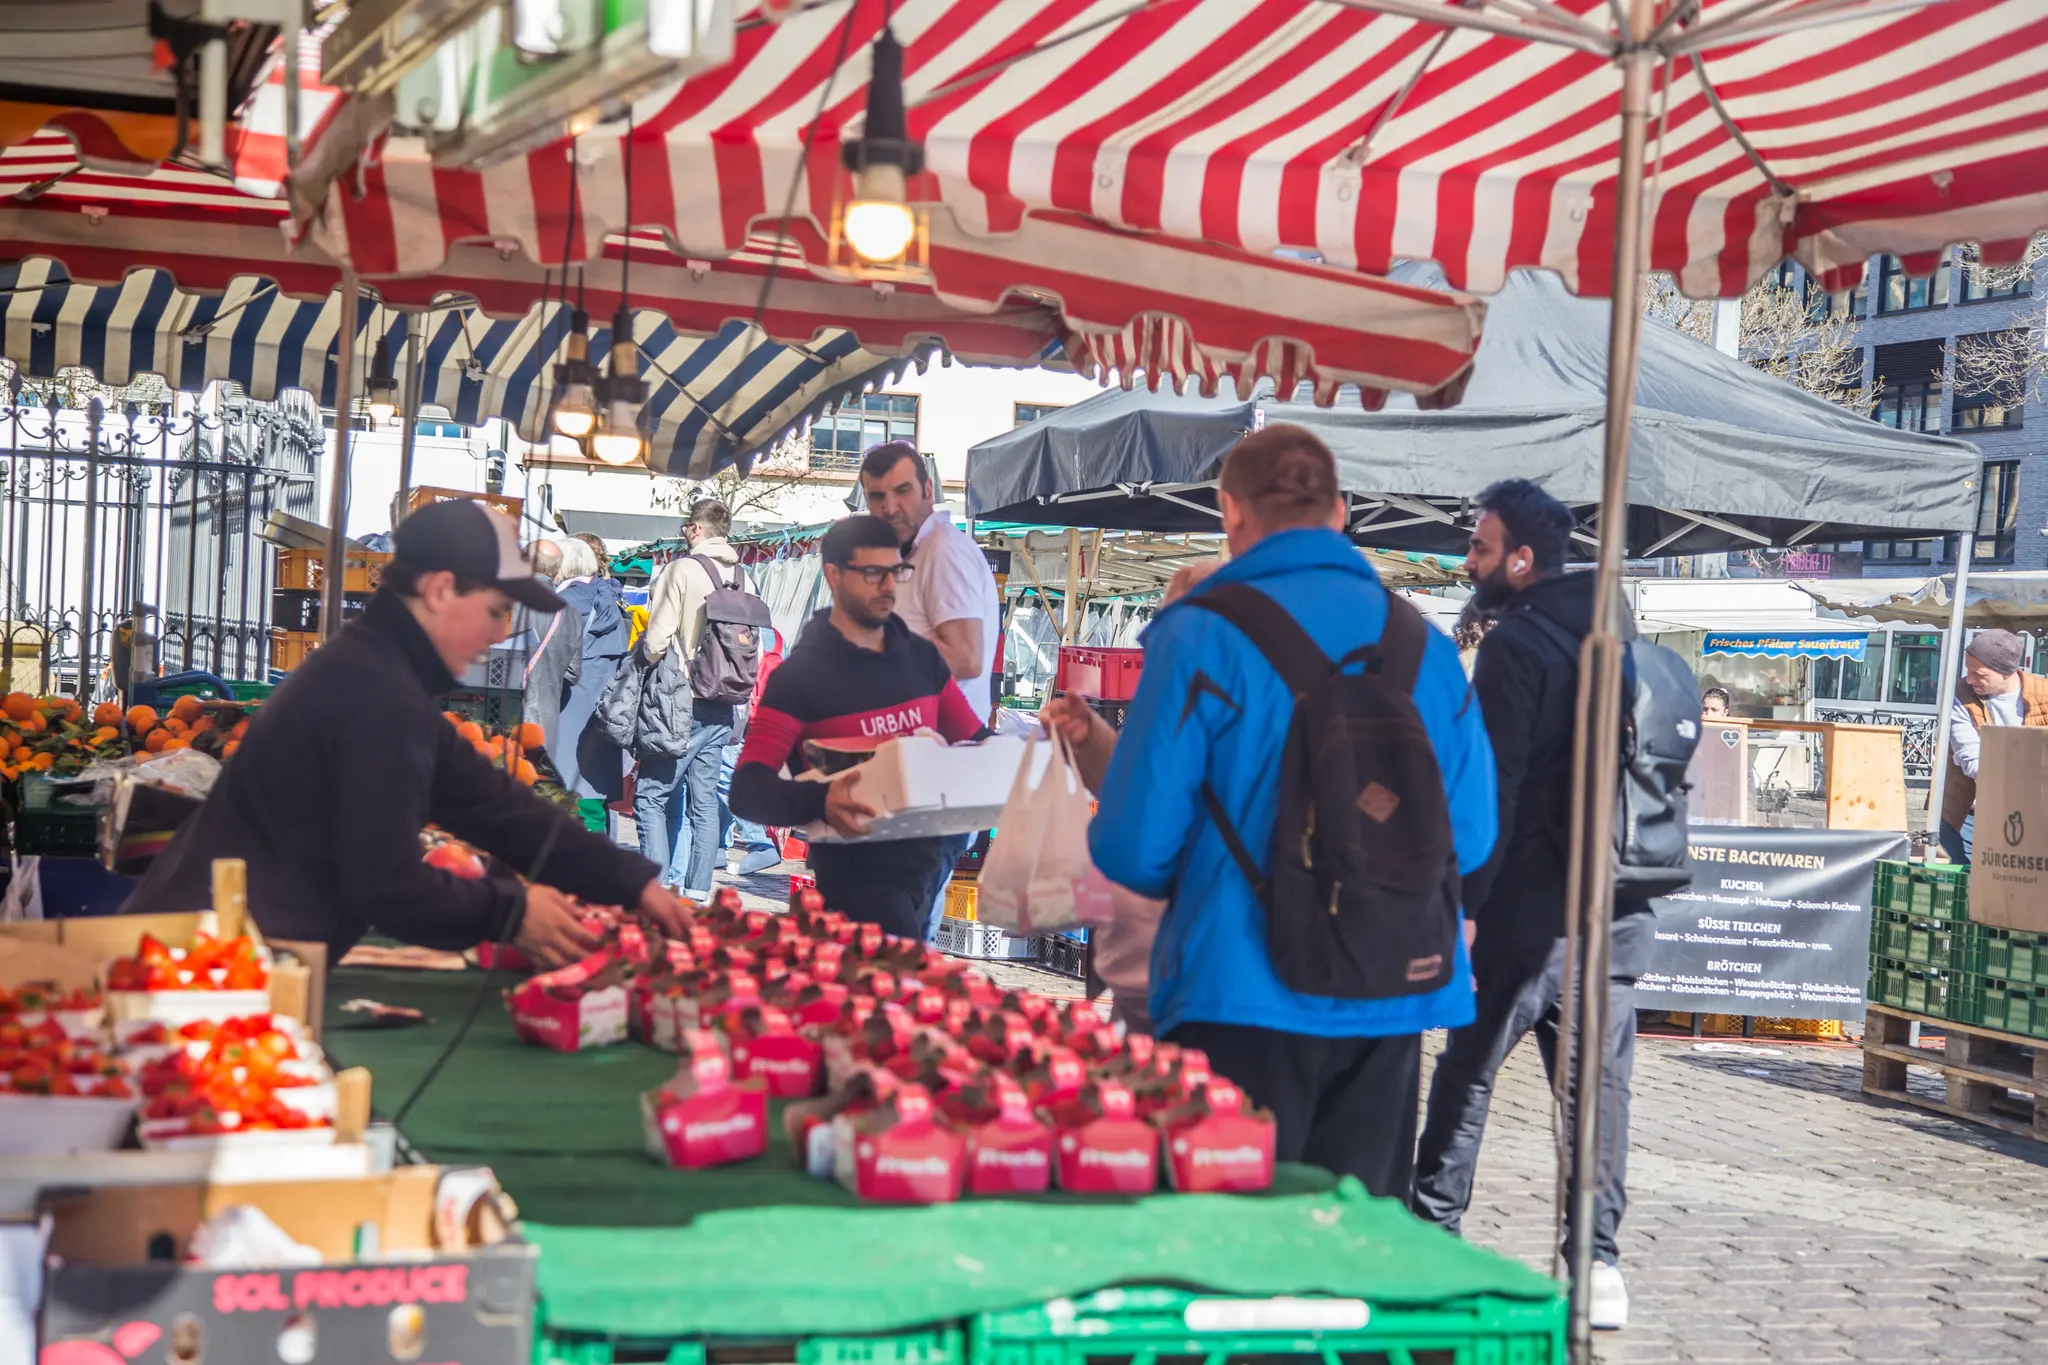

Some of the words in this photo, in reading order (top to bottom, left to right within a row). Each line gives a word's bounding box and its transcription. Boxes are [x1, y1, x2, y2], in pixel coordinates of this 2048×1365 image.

[1709, 638, 1755, 648] Frisches
[1756, 638, 1797, 649] Pfälzer
[1797, 639, 1860, 650] Sauerkraut
[860, 706, 923, 737] URBAN
[1728, 848, 1825, 870] BACKWAREN
[1720, 878, 1764, 892] KUCHEN
[1796, 900, 1831, 910] Saisonale
[1831, 901, 1861, 912] Kuchen
[1698, 916, 1731, 931] SÜSSE
[1732, 920, 1782, 934] TEILCHEN
[1684, 932, 1748, 947] Schokocroissant
[1752, 937, 1807, 949] Franzbrötchen
[1811, 941, 1833, 951] uvm.
[1706, 959, 1762, 973] BRÖTCHEN
[1671, 983, 1730, 996] Kürbisbrötchen
[1735, 987, 1794, 1000] Laugengebäck
[1799, 991, 1862, 1004] Weizenbrötchen
[1676, 974, 1729, 987] Maisbrötchen
[1734, 977, 1797, 991] Winzerbrötchen
[1802, 982, 1861, 995] Dinkelbrötchen
[213, 1273, 289, 1313] SOL
[293, 1264, 467, 1308] PRODUCE
